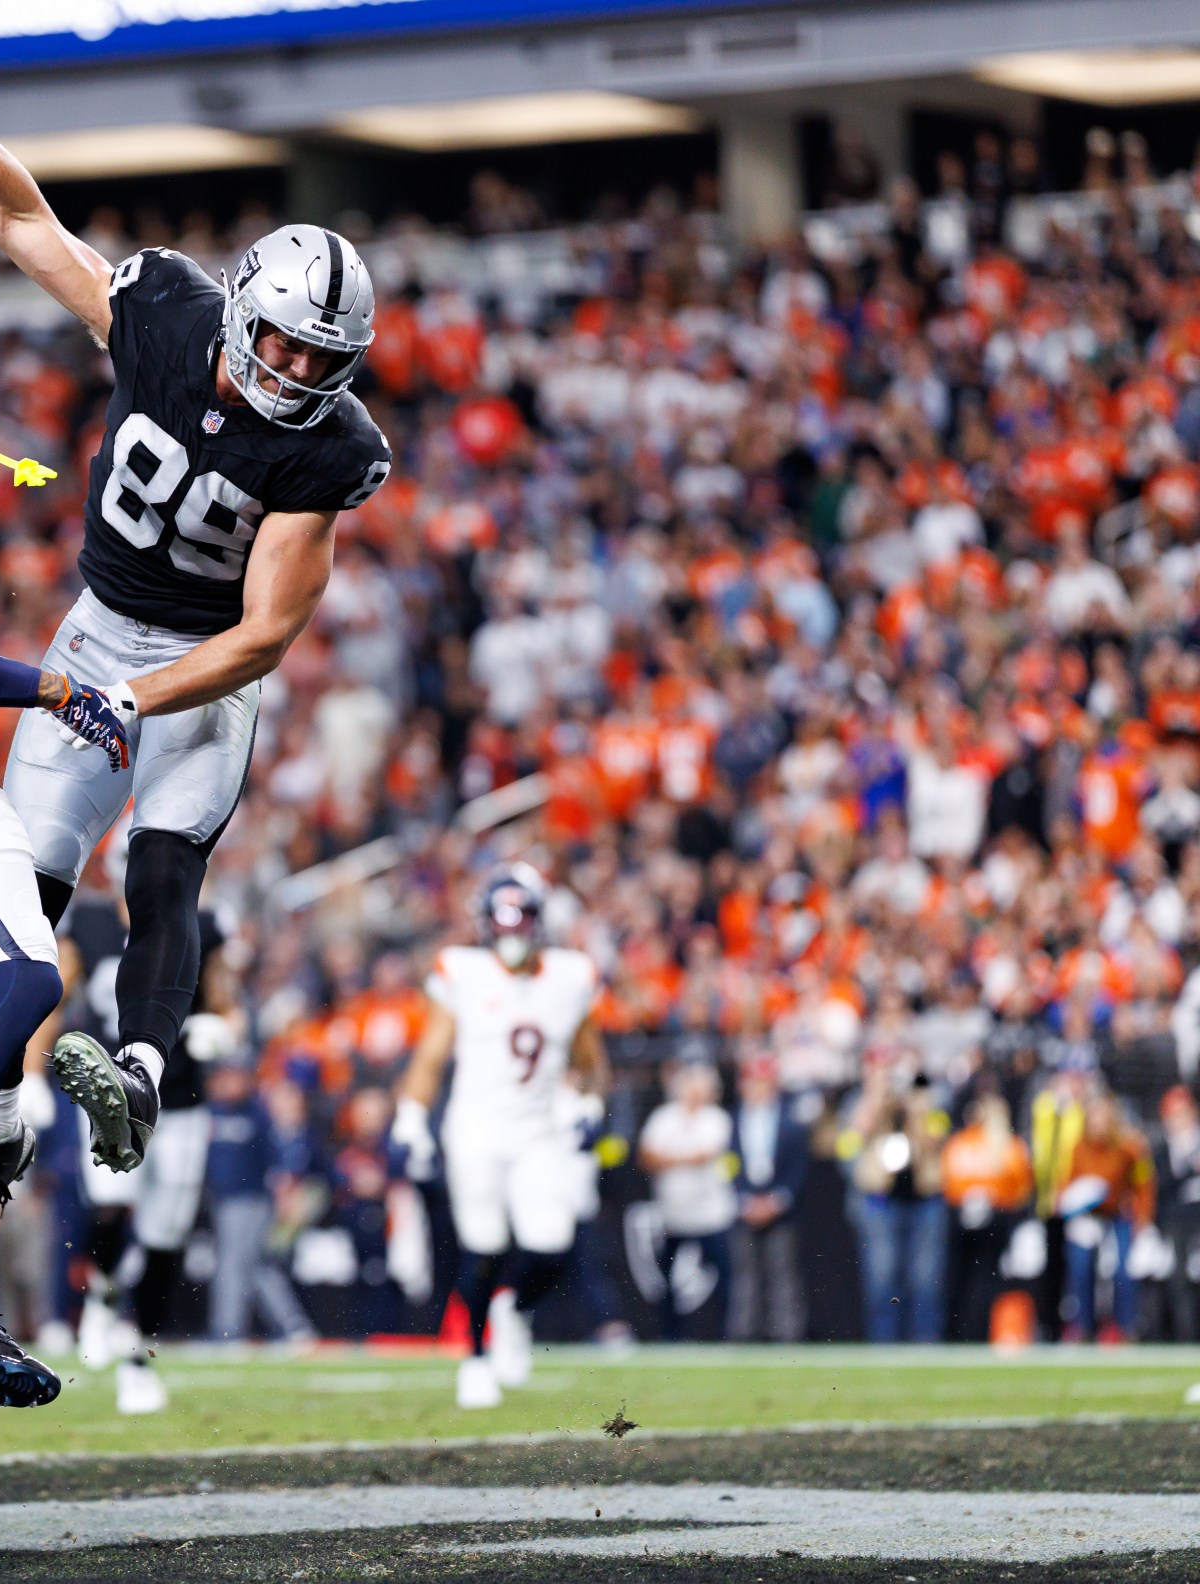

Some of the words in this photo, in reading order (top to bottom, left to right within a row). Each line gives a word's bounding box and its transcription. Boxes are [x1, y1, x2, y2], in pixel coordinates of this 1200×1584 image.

[311, 323, 340, 337] RAIDERS
[102, 413, 263, 581] 89
[509, 1022, 545, 1084] 9
